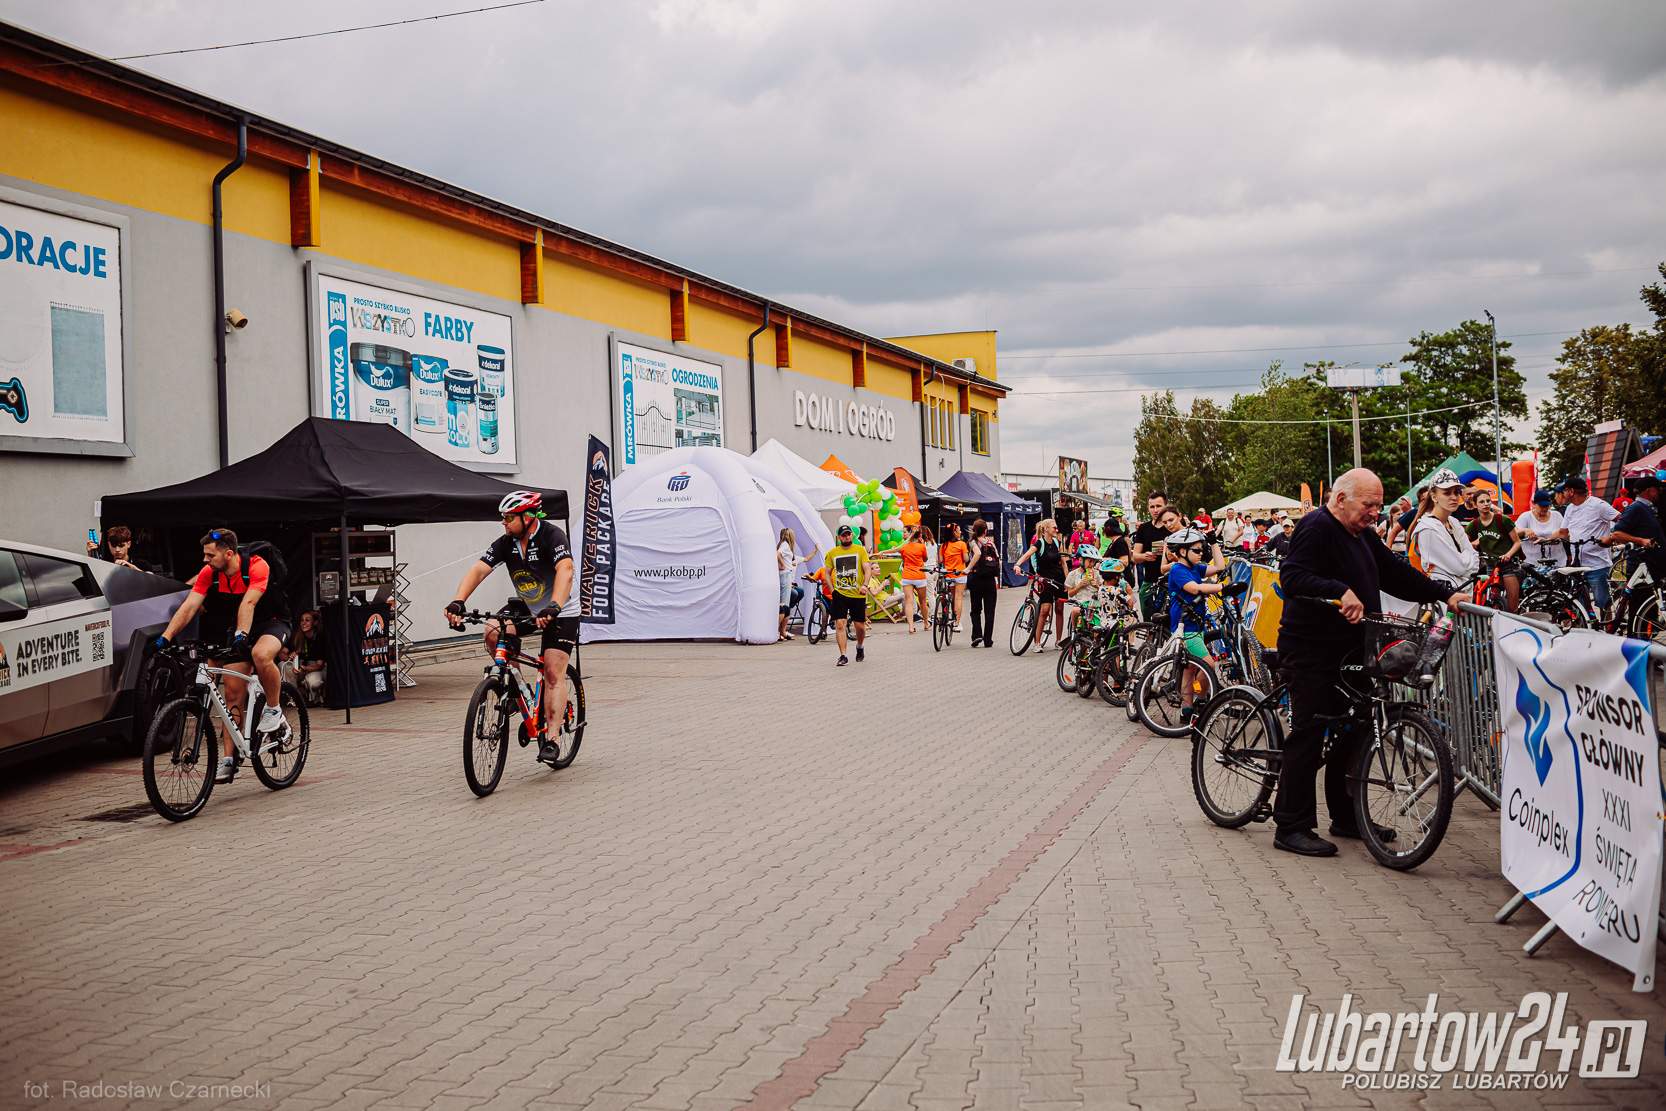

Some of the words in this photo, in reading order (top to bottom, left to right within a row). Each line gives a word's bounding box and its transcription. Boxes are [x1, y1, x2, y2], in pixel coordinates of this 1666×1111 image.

[0, 225, 107, 279] ORACJE
[353, 297, 374, 308] PROSTO
[374, 301, 394, 312] SZYBKO
[424, 312, 475, 344] FARBY
[370, 373, 393, 388] Dulux
[419, 368, 440, 381] Dulux
[671, 367, 719, 391] OGRODZENIA
[625, 392, 634, 459] MRÓWKA
[794, 389, 834, 432] DOM
[837, 399, 843, 434] I
[846, 399, 895, 441] OGRÓD
[580, 474, 604, 618] MAVERICK
[595, 480, 613, 566] PACKAGE
[592, 573, 610, 618] FOOD
[633, 565, 706, 580] www.pkobp.pl
[16, 630, 80, 661] ADVENTURE
[17, 662, 29, 678] IN
[31, 653, 60, 674] EVERY
[61, 648, 82, 667] BITE.
[1575, 684, 1645, 736] SPONSOR
[1581, 729, 1645, 788] GŁÓWNY
[1508, 788, 1570, 858] Coinplex
[1602, 788, 1632, 833] XXXI
[1595, 826, 1638, 888] ŚWIĘTA
[1572, 879, 1641, 944] ROWERU
